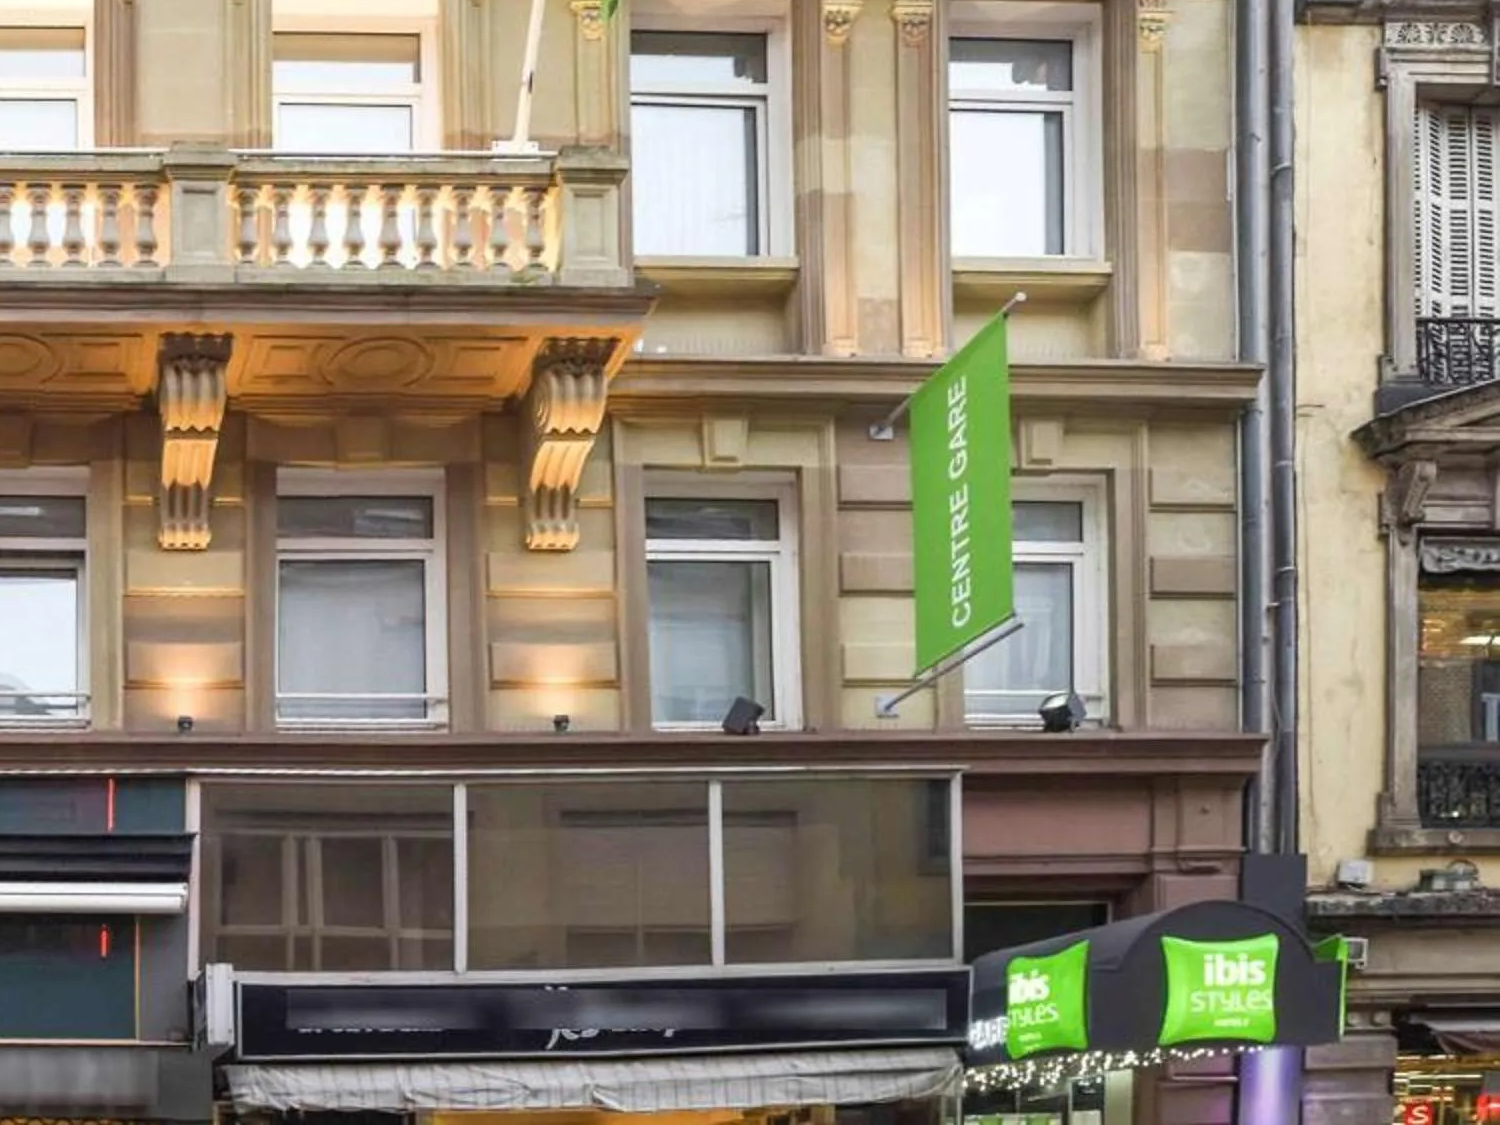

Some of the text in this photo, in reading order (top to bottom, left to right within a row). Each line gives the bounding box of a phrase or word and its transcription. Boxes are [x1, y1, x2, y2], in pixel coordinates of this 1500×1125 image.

[947, 375, 972, 628] CENTRE GARE
[1203, 953, 1266, 987] ibis
